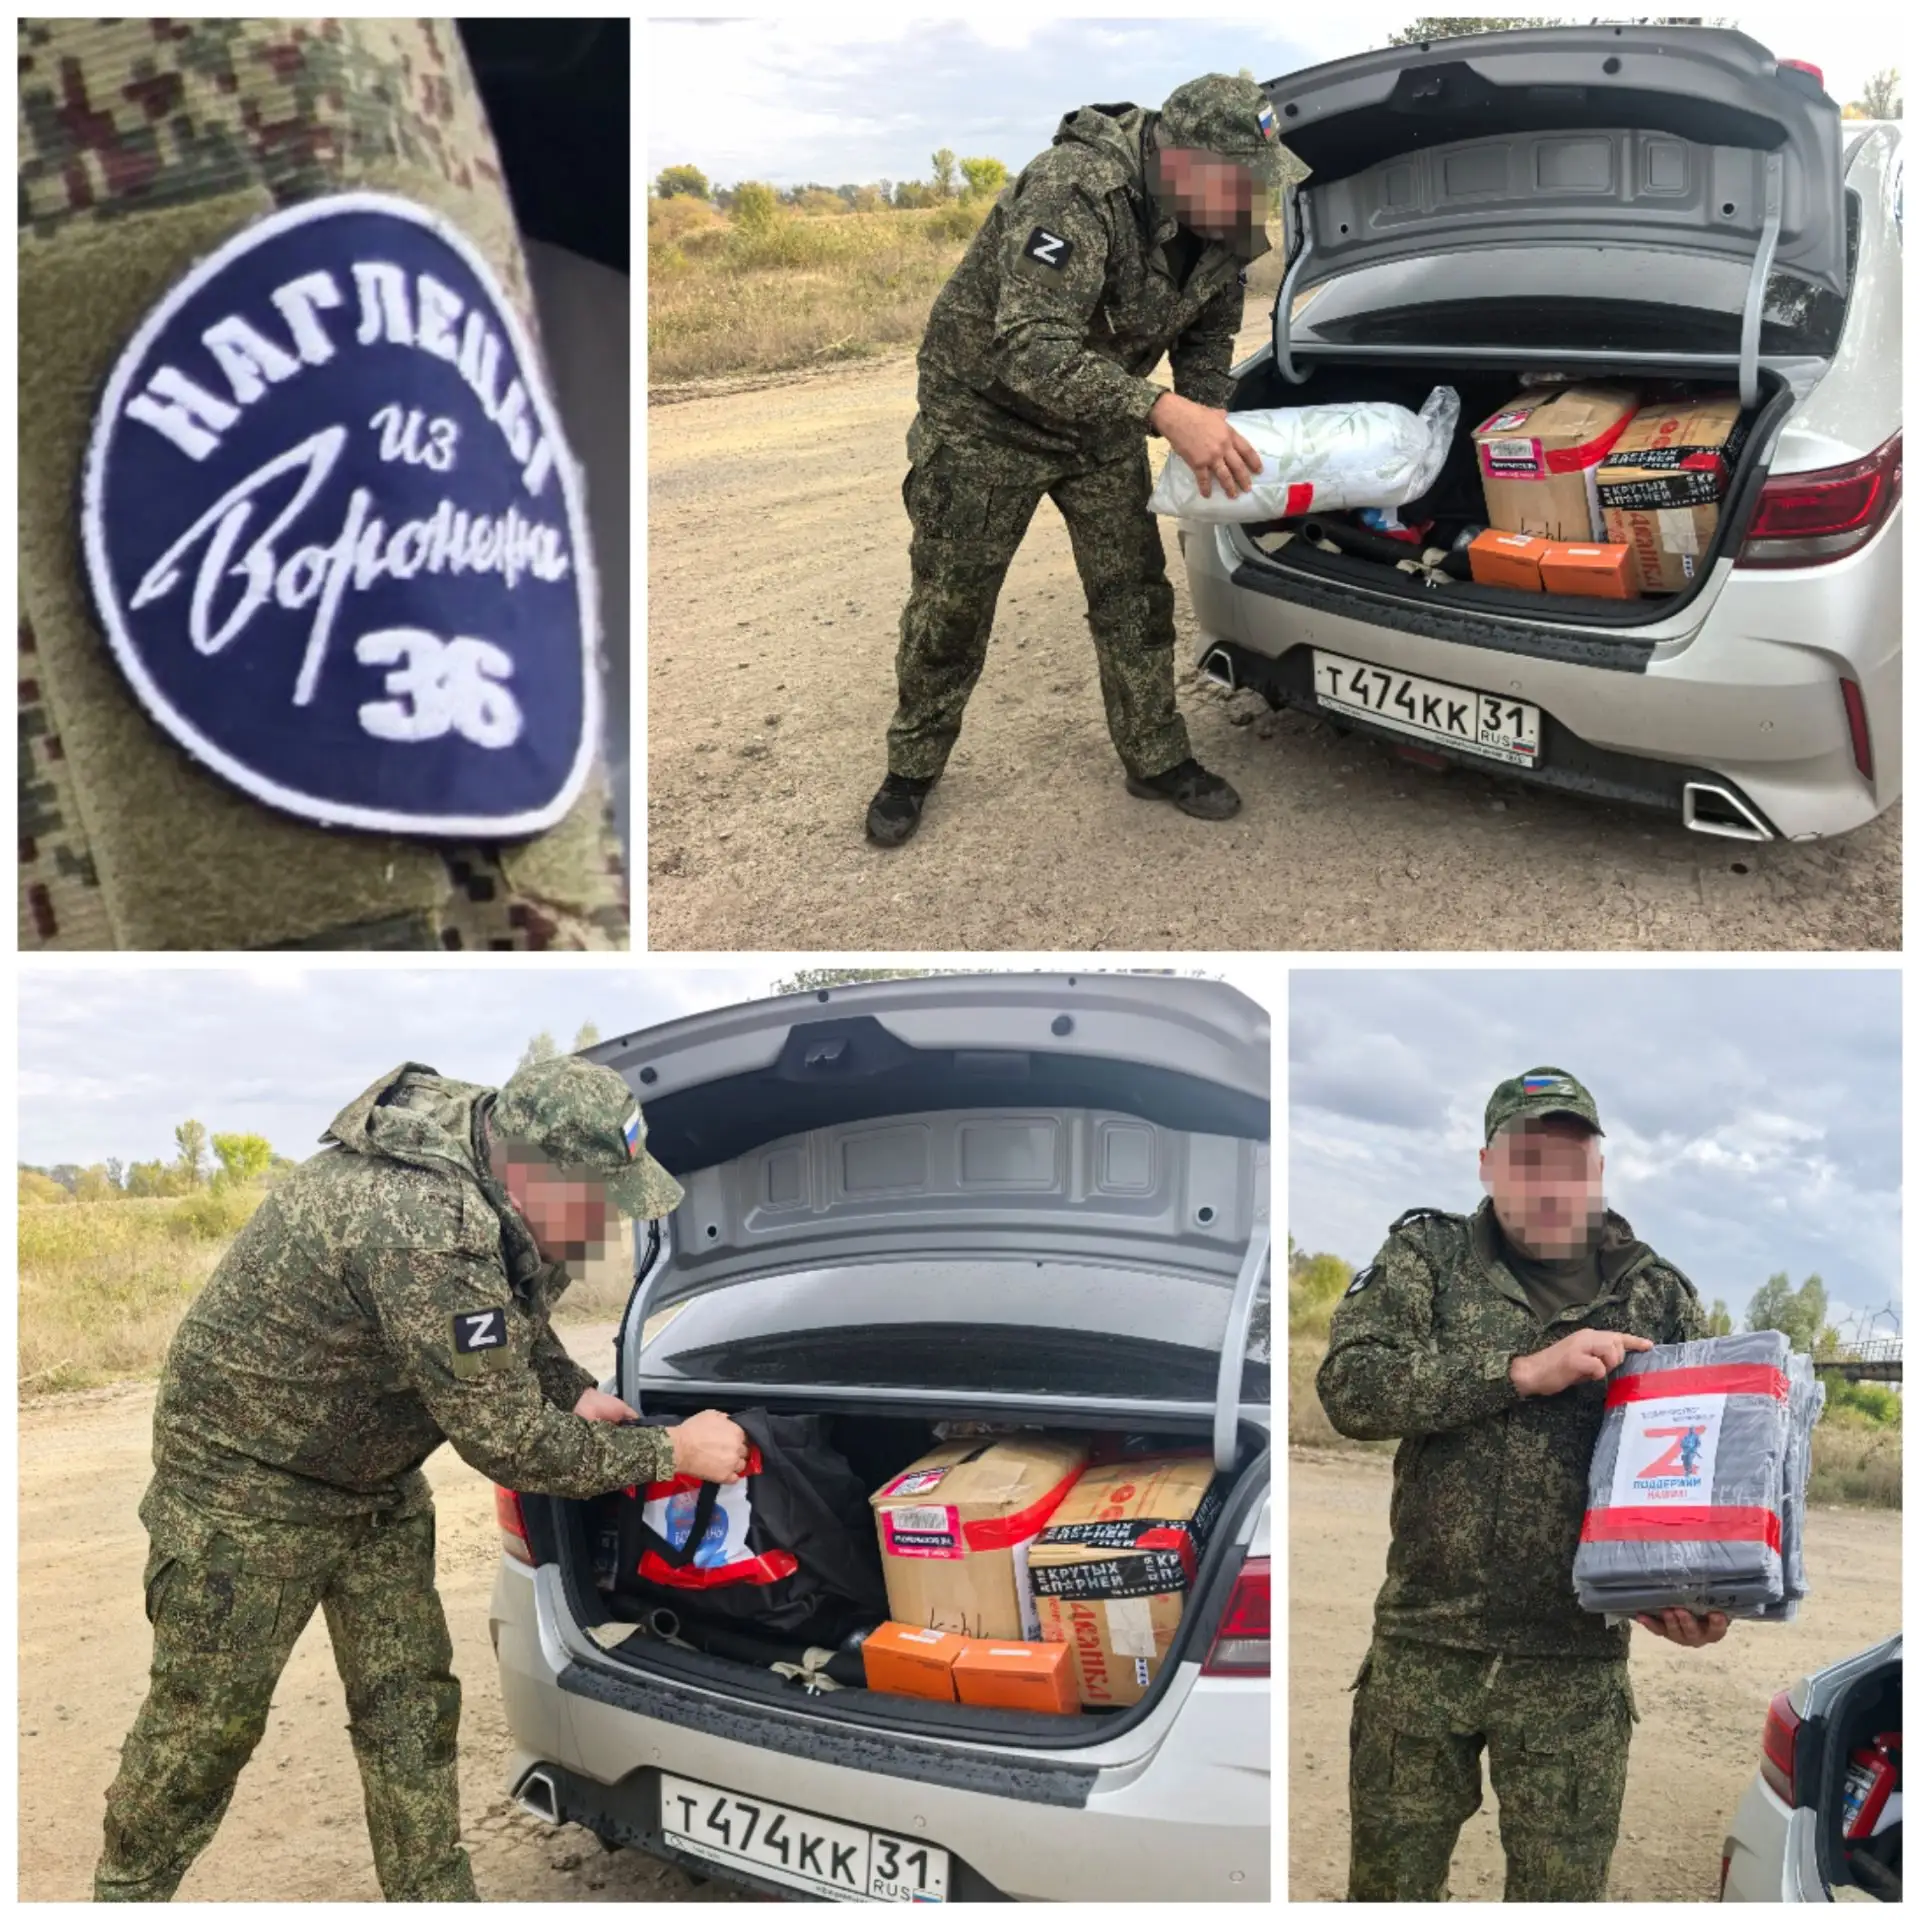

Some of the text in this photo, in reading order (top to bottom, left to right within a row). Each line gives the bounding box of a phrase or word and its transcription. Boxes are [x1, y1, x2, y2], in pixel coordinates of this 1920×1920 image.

[1033, 232, 1064, 264] Z
[124, 260, 557, 496] НАГЛЕЦЫ
[1612, 480, 1668, 496] КРУТЫХ
[354, 627, 524, 749] 36
[1483, 699, 1524, 738] 31
[1480, 729, 1511, 748] RUS
[465, 1312, 498, 1348] Z
[1047, 1561, 1119, 1579] КРУТЫХ
[876, 1839, 928, 1889] 31
[872, 1878, 911, 1902] RUS
